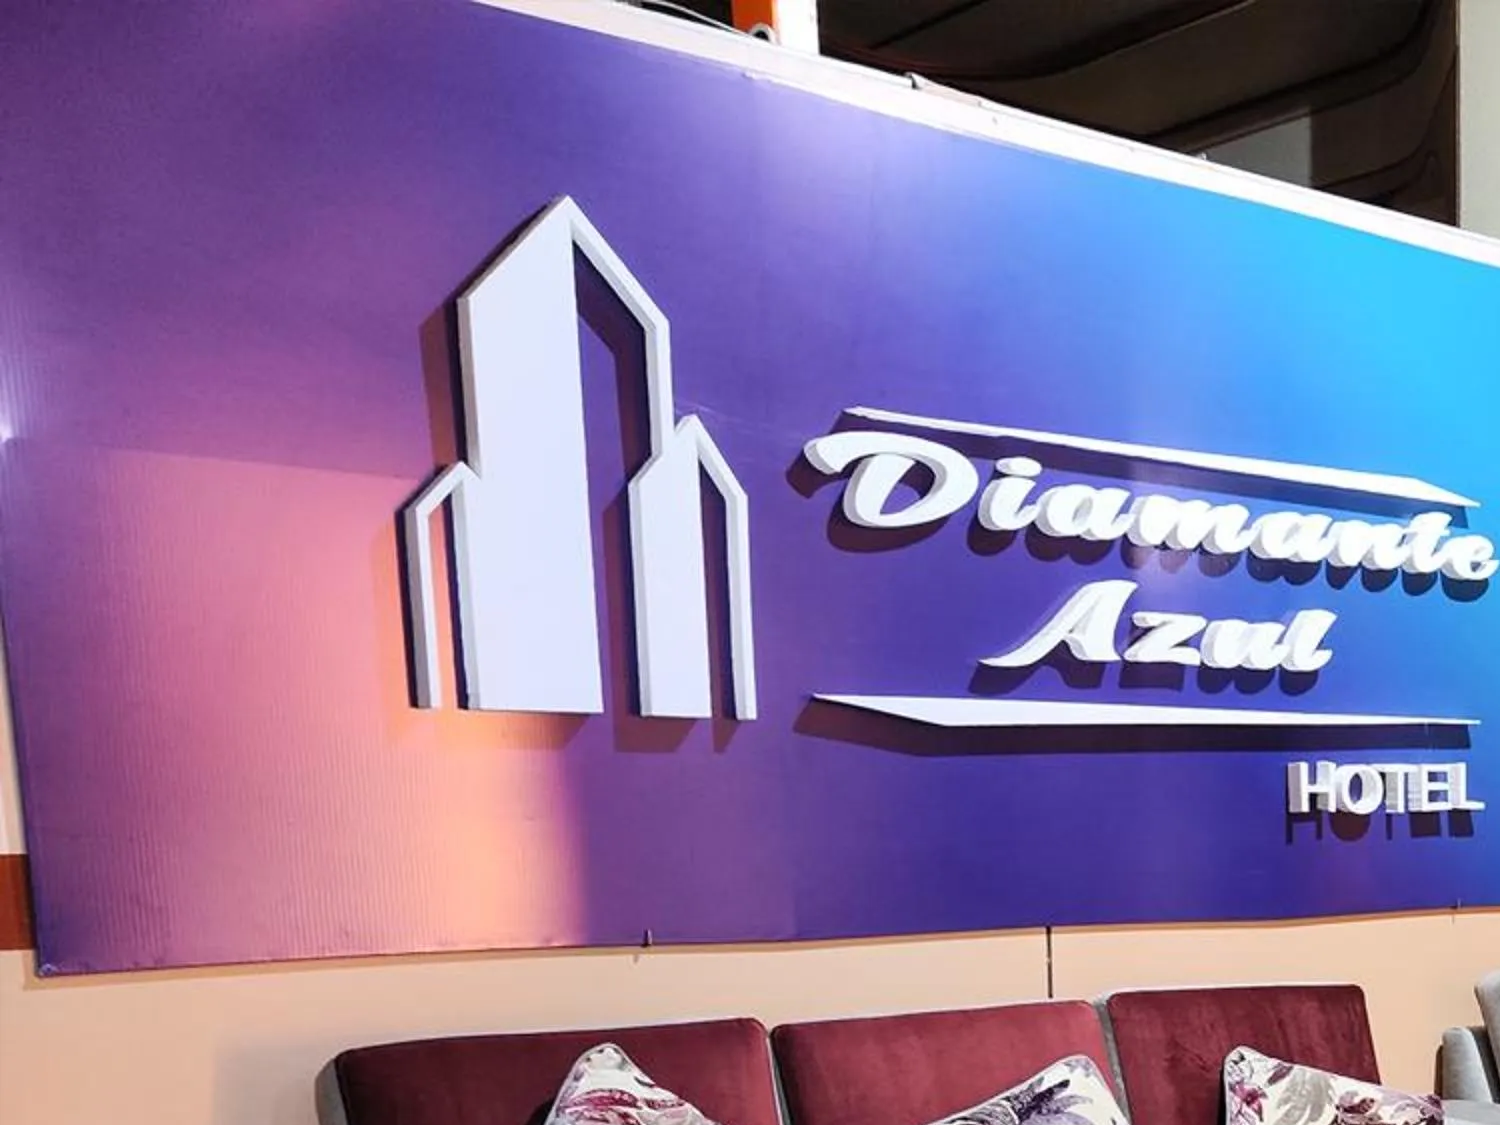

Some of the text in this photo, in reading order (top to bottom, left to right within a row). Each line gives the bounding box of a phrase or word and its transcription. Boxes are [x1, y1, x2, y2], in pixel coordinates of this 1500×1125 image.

[804, 431, 1500, 581] Diamante
[977, 580, 1337, 671] Azul
[1287, 761, 1485, 815] HOTEL
